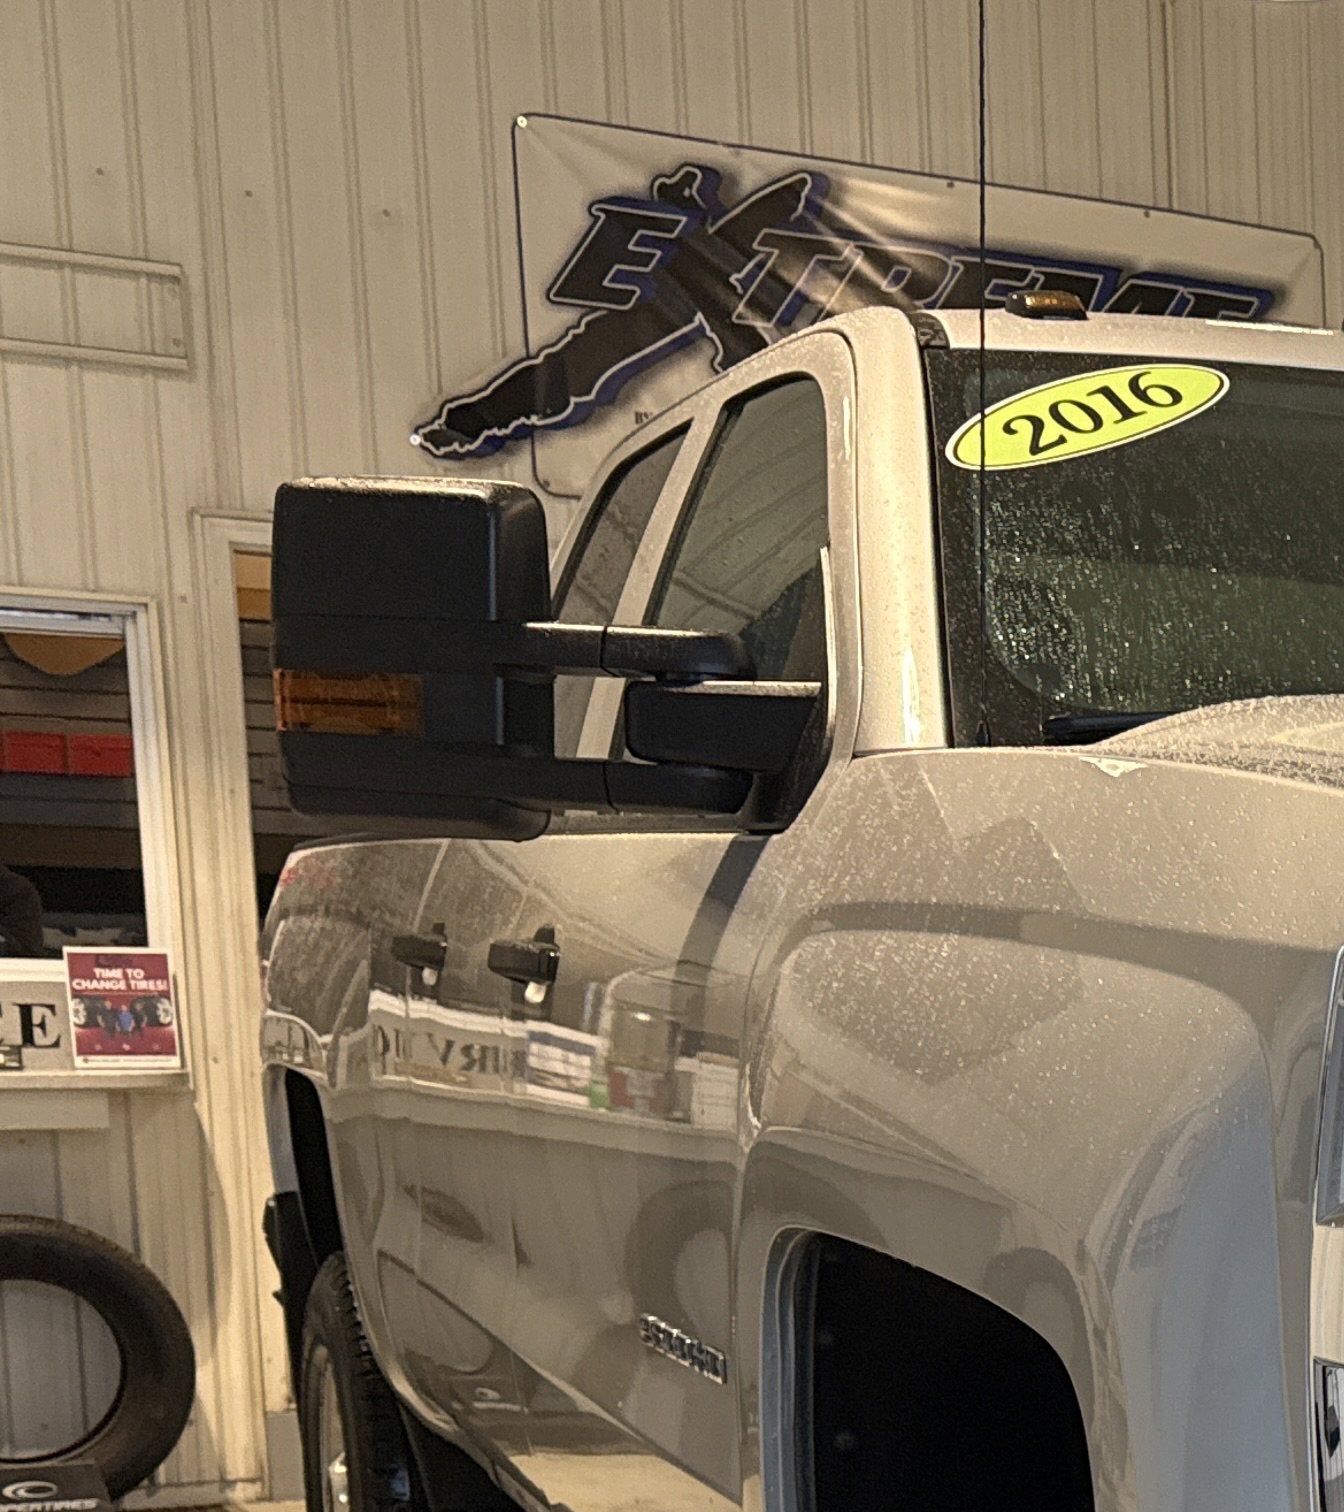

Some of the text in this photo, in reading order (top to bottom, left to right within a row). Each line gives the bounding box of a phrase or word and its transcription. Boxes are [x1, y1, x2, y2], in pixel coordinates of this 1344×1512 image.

[1002, 371, 1183, 456] 2016
[93, 967, 145, 979] TIME TO
[72, 979, 168, 991] CHANGE TIRES!
